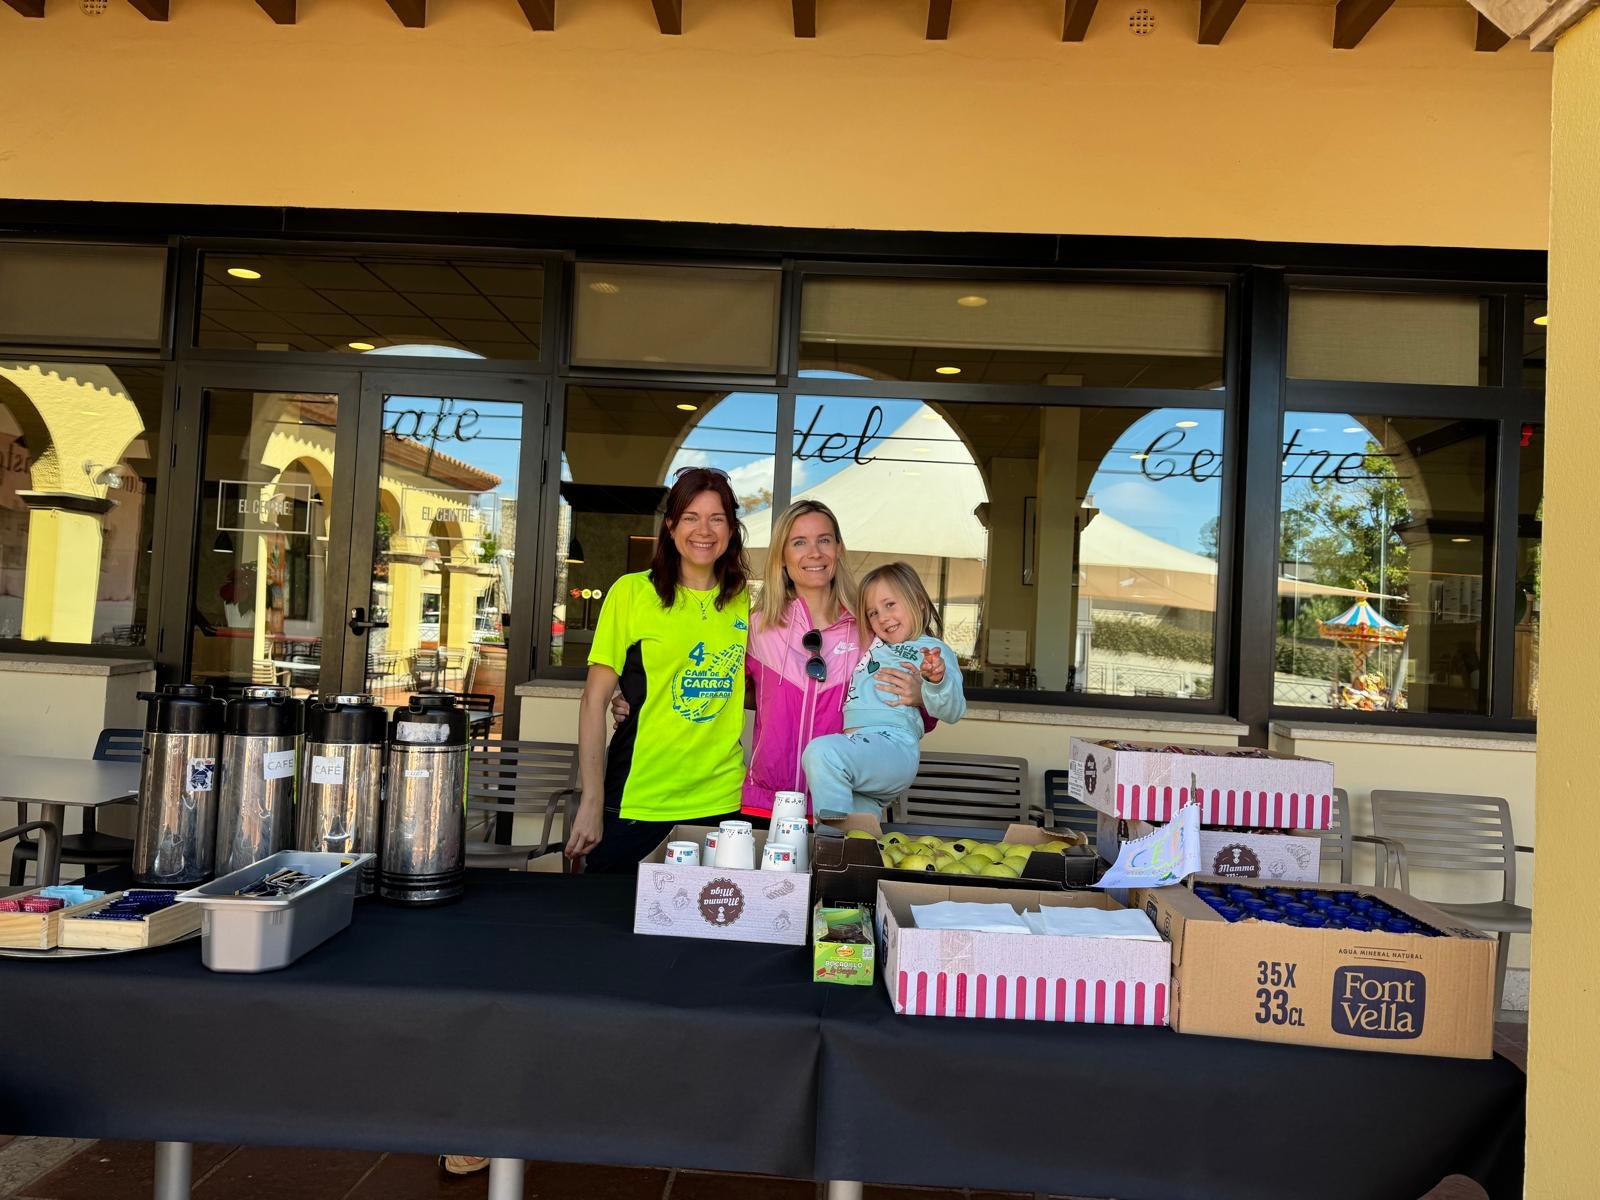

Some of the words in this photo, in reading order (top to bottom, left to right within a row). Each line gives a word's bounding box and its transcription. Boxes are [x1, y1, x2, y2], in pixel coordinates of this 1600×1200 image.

[383, 394, 481, 442] afe
[794, 404, 883, 465] del
[1141, 427, 1366, 484] Cetre
[239, 499, 250, 513] EL
[422, 506, 434, 521] EL
[437, 507, 474, 523] CENTRE
[688, 641, 705, 667] 4
[683, 679, 731, 689] CARROS
[1218, 864, 1255, 873] Mamma
[710, 887, 735, 897] Miga
[703, 897, 740, 907] Mamma
[1392, 952, 1424, 960] NATURAL
[1257, 960, 1297, 988] 35X
[1343, 971, 1415, 1003] Font
[1340, 1001, 1416, 1033] Vella
